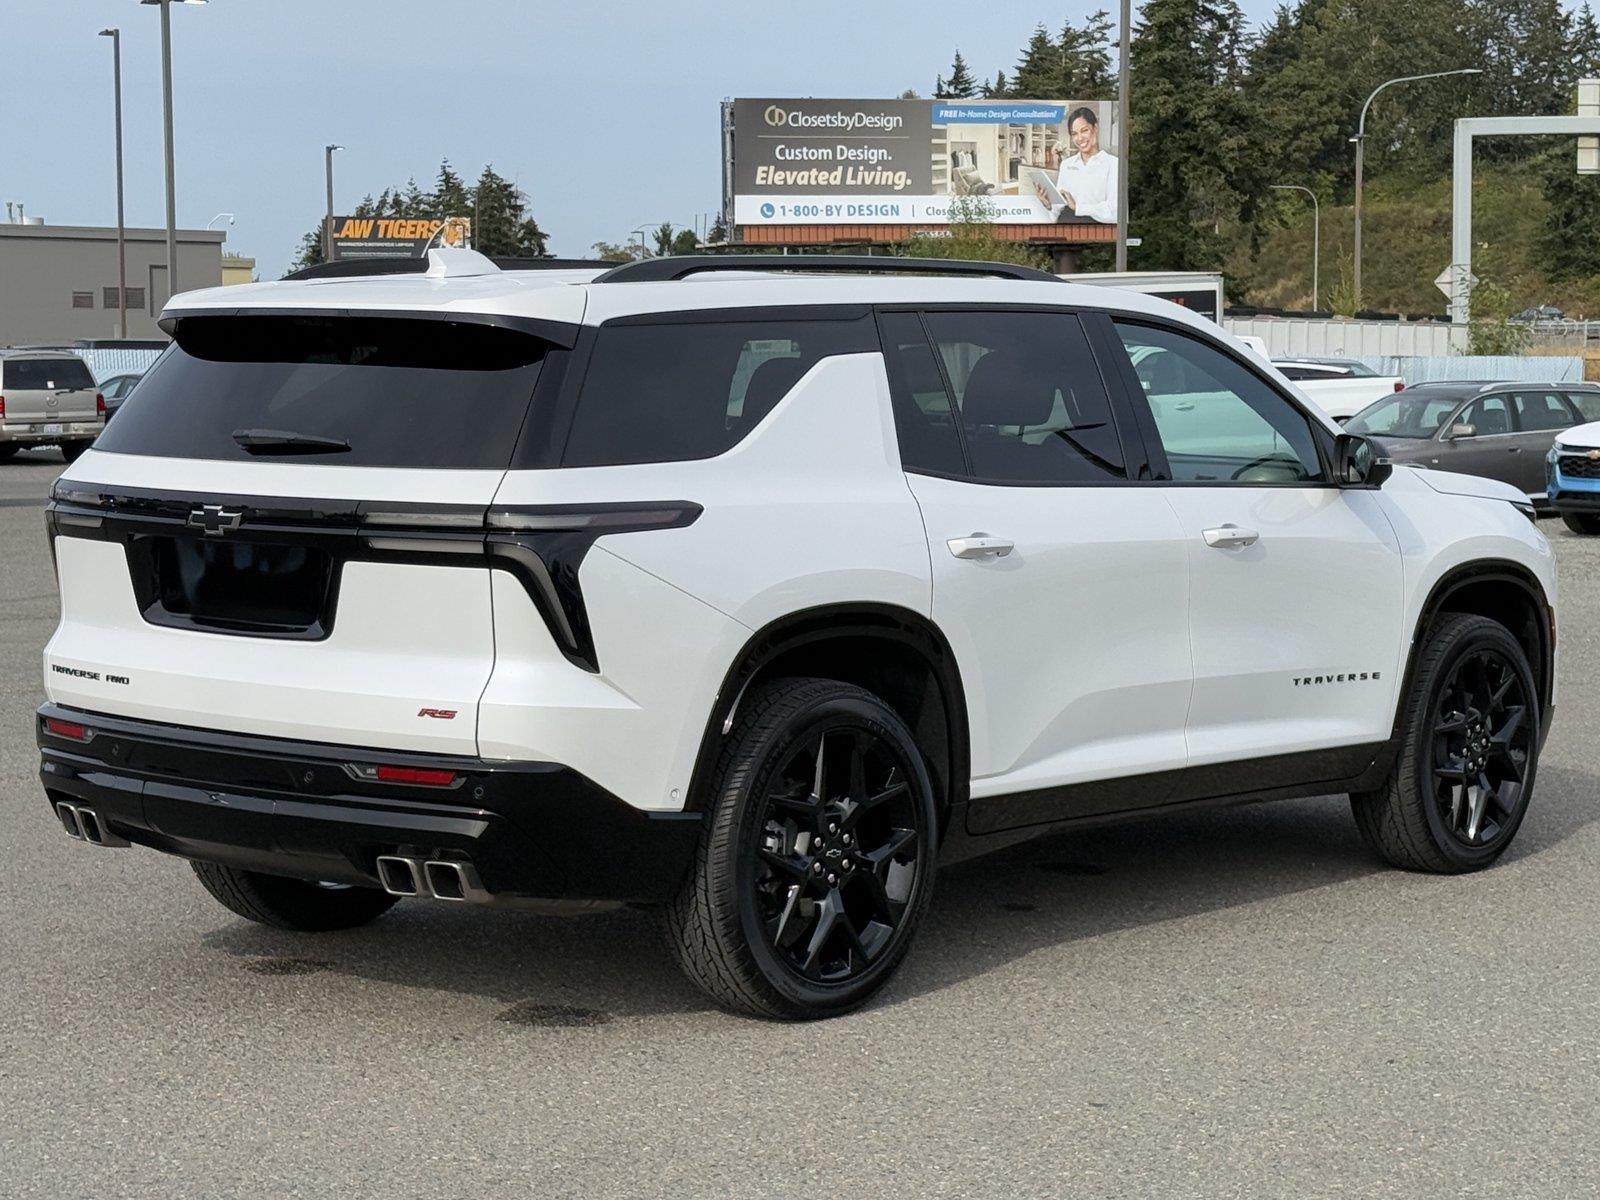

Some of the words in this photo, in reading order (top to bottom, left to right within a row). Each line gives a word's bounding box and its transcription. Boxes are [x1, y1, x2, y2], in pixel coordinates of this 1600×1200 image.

[787, 111, 903, 131] ClosetsbyDesign
[939, 109, 958, 118] FREE
[958, 110, 987, 118] In-Home
[987, 110, 1011, 120] Design
[1012, 110, 1058, 118] Consultation!
[775, 145, 833, 161] Custom
[836, 145, 892, 164] Design.
[755, 165, 843, 186] Elevated
[845, 166, 912, 190] Living.
[780, 204, 843, 217] 1-800-BY
[847, 204, 900, 217] DESIGN
[925, 206, 1032, 218] ClossDsign.com
[332, 219, 375, 239] LAW
[377, 219, 443, 239] TIGERS
[52, 664, 101, 681] TRAVERSE
[105, 674, 130, 685] AWD
[1293, 671, 1381, 686] TRAVERSE
[417, 708, 458, 719] RS
